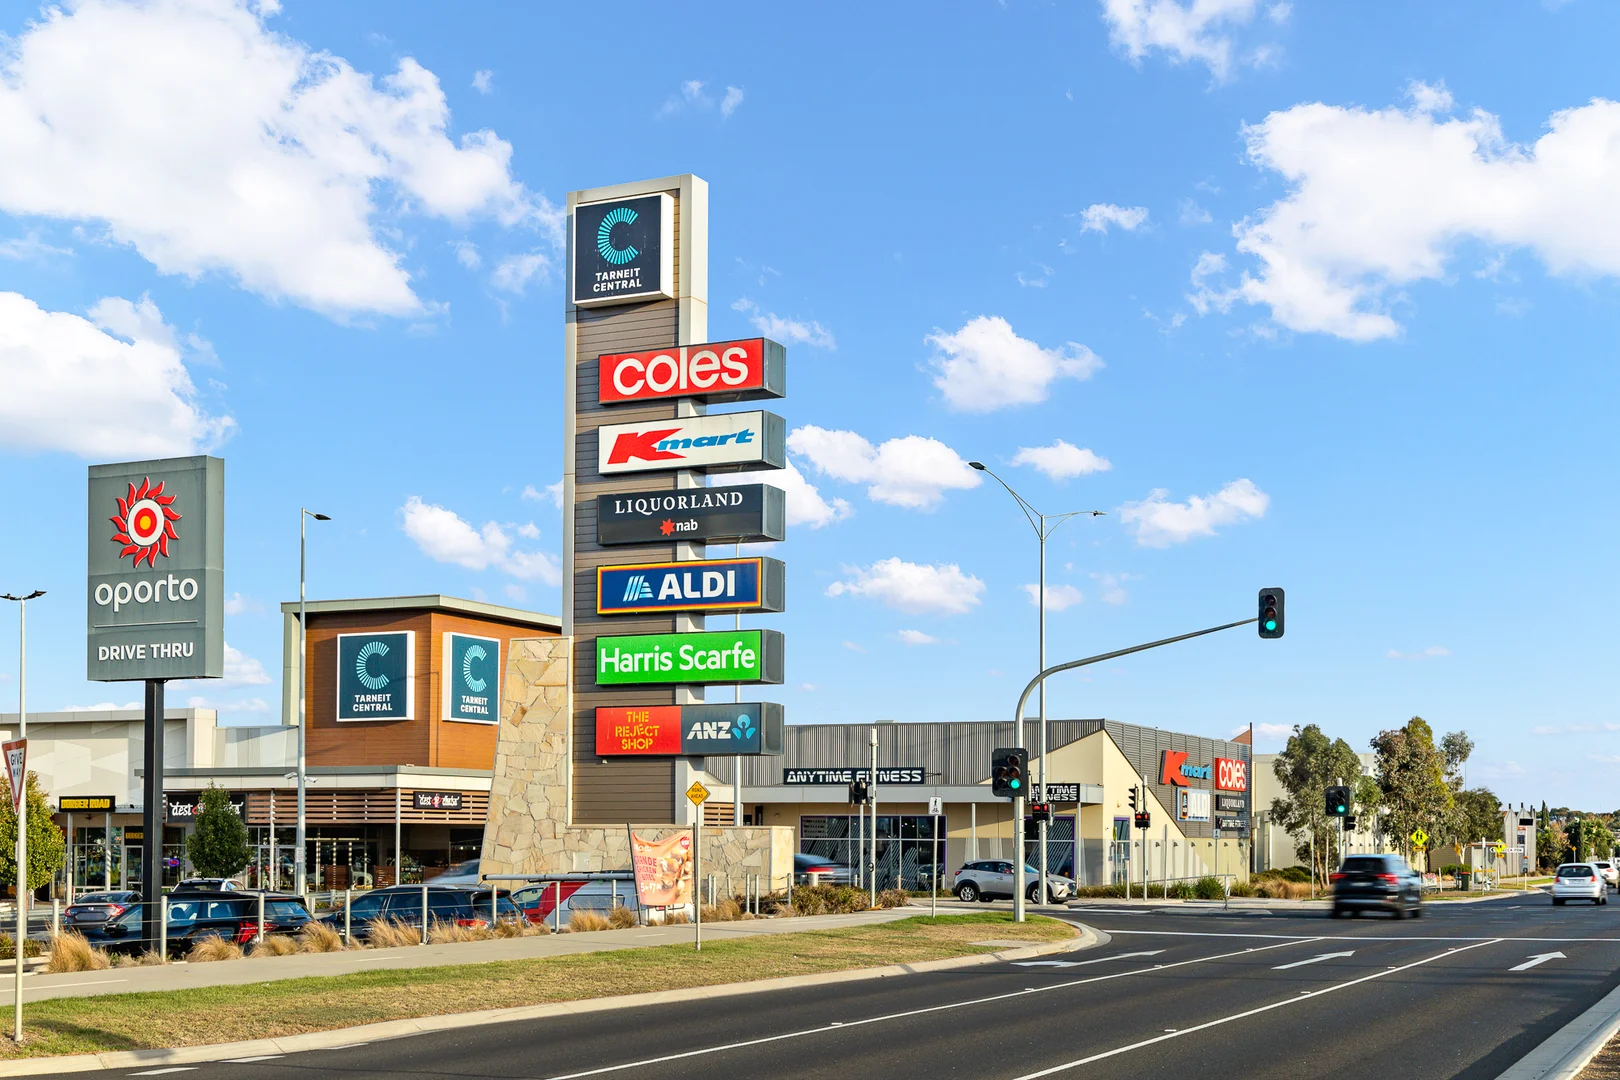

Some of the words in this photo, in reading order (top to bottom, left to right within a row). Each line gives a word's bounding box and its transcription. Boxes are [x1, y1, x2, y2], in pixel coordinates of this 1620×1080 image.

[595, 267, 641, 282] TARNEIT
[593, 278, 642, 293] CENTRAL
[613, 346, 749, 396] coles
[607, 427, 755, 465] Kmart
[615, 491, 743, 516] LIQUORLAND
[675, 519, 698, 533] nab
[657, 570, 736, 600] ALDI
[94, 573, 199, 613] oporto
[98, 643, 146, 661] DRIVE
[150, 642, 194, 659] THRU
[600, 645, 673, 673] Harris
[679, 641, 756, 671] Scarfe
[354, 693, 392, 702] TARNEIT
[461, 696, 488, 705] TARNEIT
[352, 703, 393, 712] CENTRAL
[460, 704, 489, 715] CENTRAL
[626, 711, 650, 723] THE
[615, 723, 660, 738] REJECT
[686, 721, 732, 740] ANZ
[621, 738, 654, 750] SHOP
[1162, 750, 1212, 786] Kmart
[1220, 760, 1246, 789] coles
[786, 770, 852, 783] ANYTIME
[856, 770, 922, 783] FINESS
[89, 798, 111, 809] ROAD
[1031, 793, 1078, 801] FINESS
